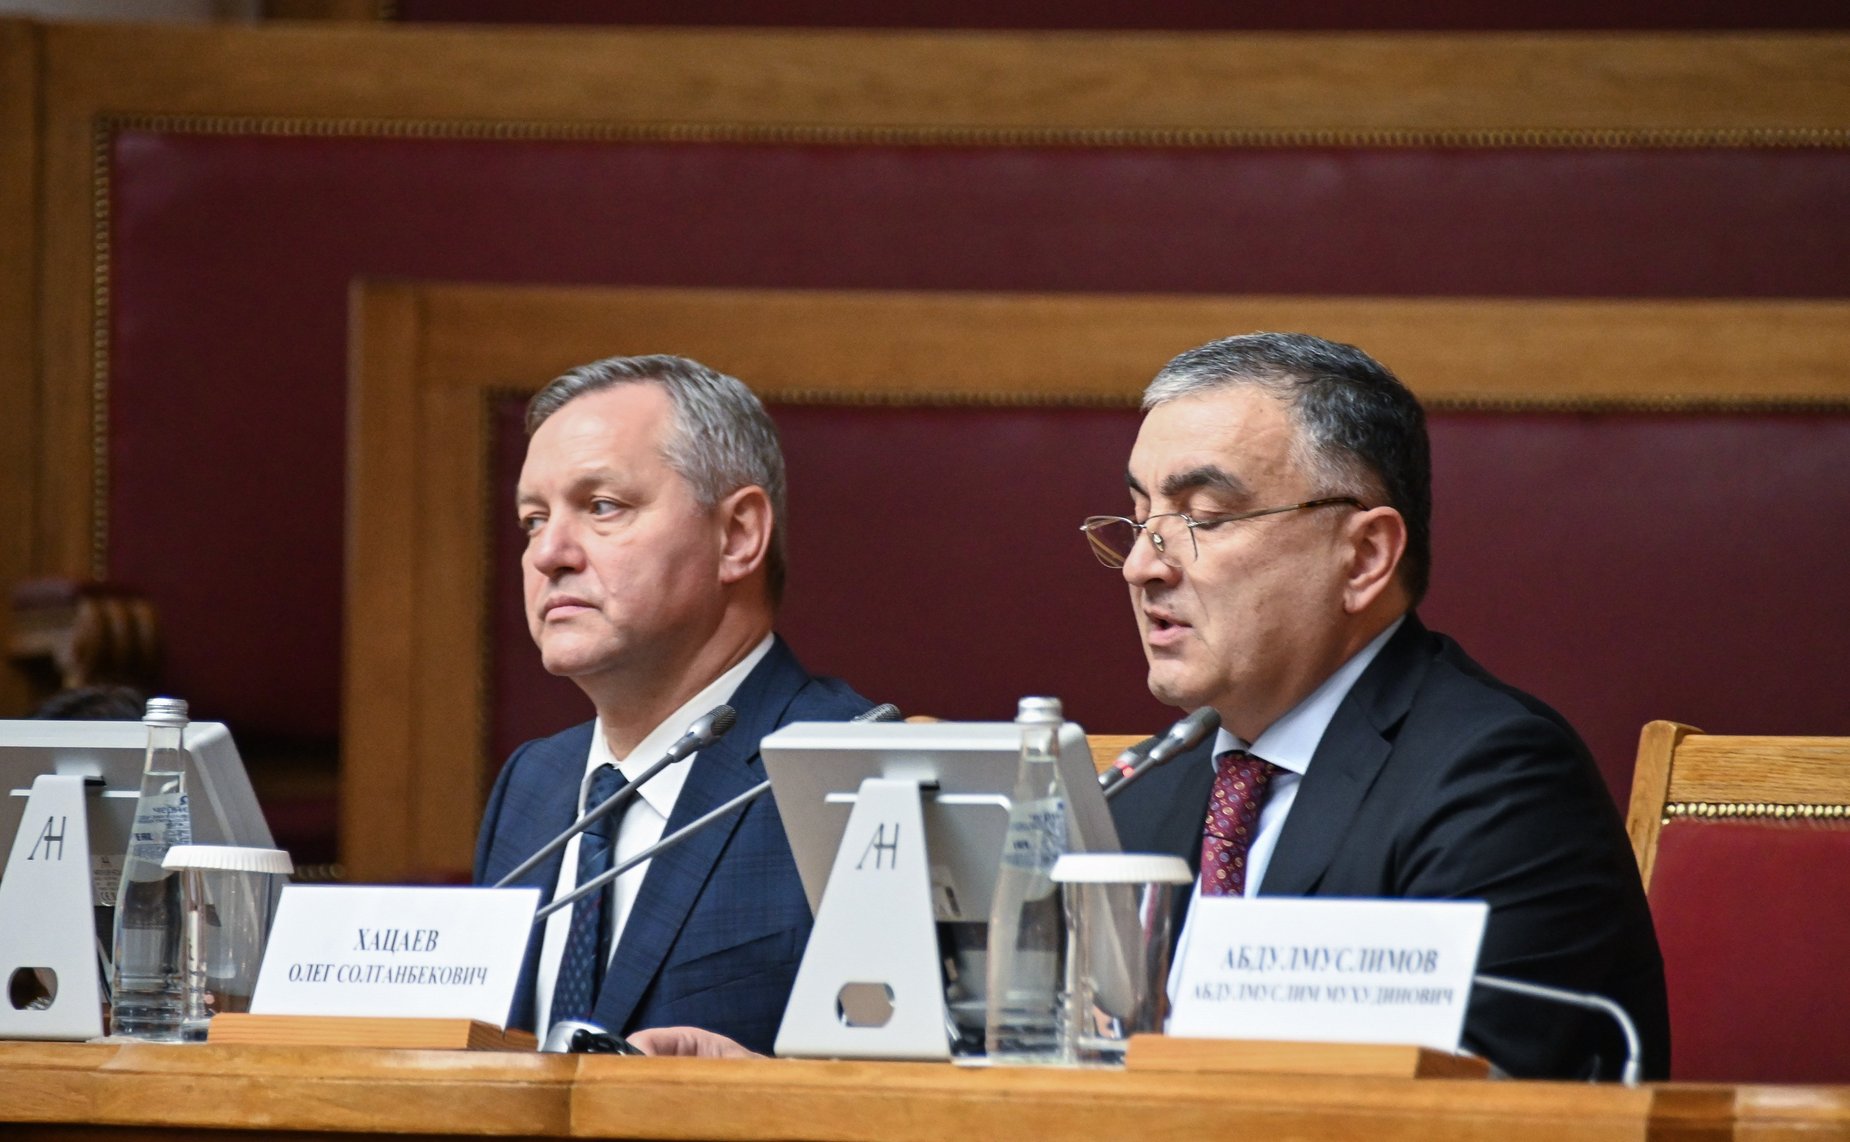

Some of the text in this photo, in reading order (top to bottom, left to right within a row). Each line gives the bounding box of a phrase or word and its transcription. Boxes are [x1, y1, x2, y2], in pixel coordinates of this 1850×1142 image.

[353, 928, 439, 955] ХАЦАЕВ
[1220, 945, 1439, 975] АБДУЛМУСЛИМОВ
[288, 963, 488, 986] ОЛЕГ СОЛТАНБЕКОВИЧ
[1192, 982, 1321, 1003] АБДУЛМУСЛИМ
